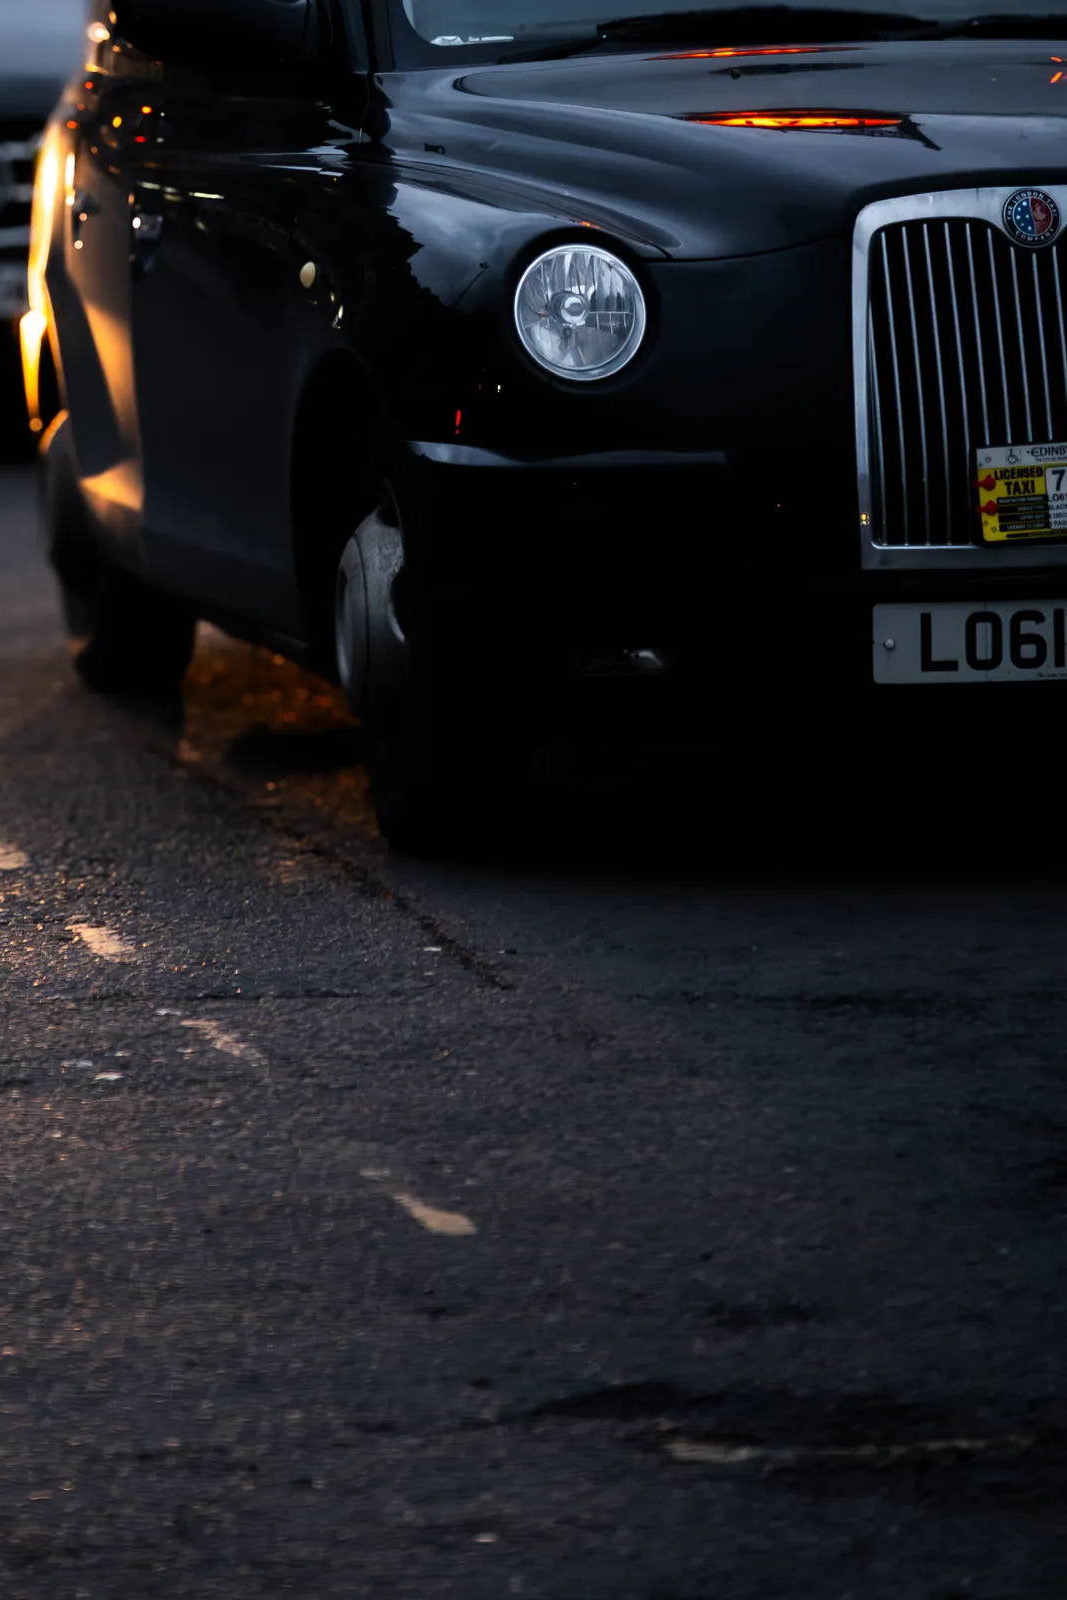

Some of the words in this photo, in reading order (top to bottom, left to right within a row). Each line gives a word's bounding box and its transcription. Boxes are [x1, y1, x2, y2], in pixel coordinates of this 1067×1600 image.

[1006, 205, 1014, 221] THE
[1012, 191, 1045, 204] LONDON
[1046, 198, 1058, 217] TAXI
[1014, 227, 1055, 242] COMPANY
[994, 467, 1043, 480] LICENSED
[1004, 480, 1036, 495] TAXI
